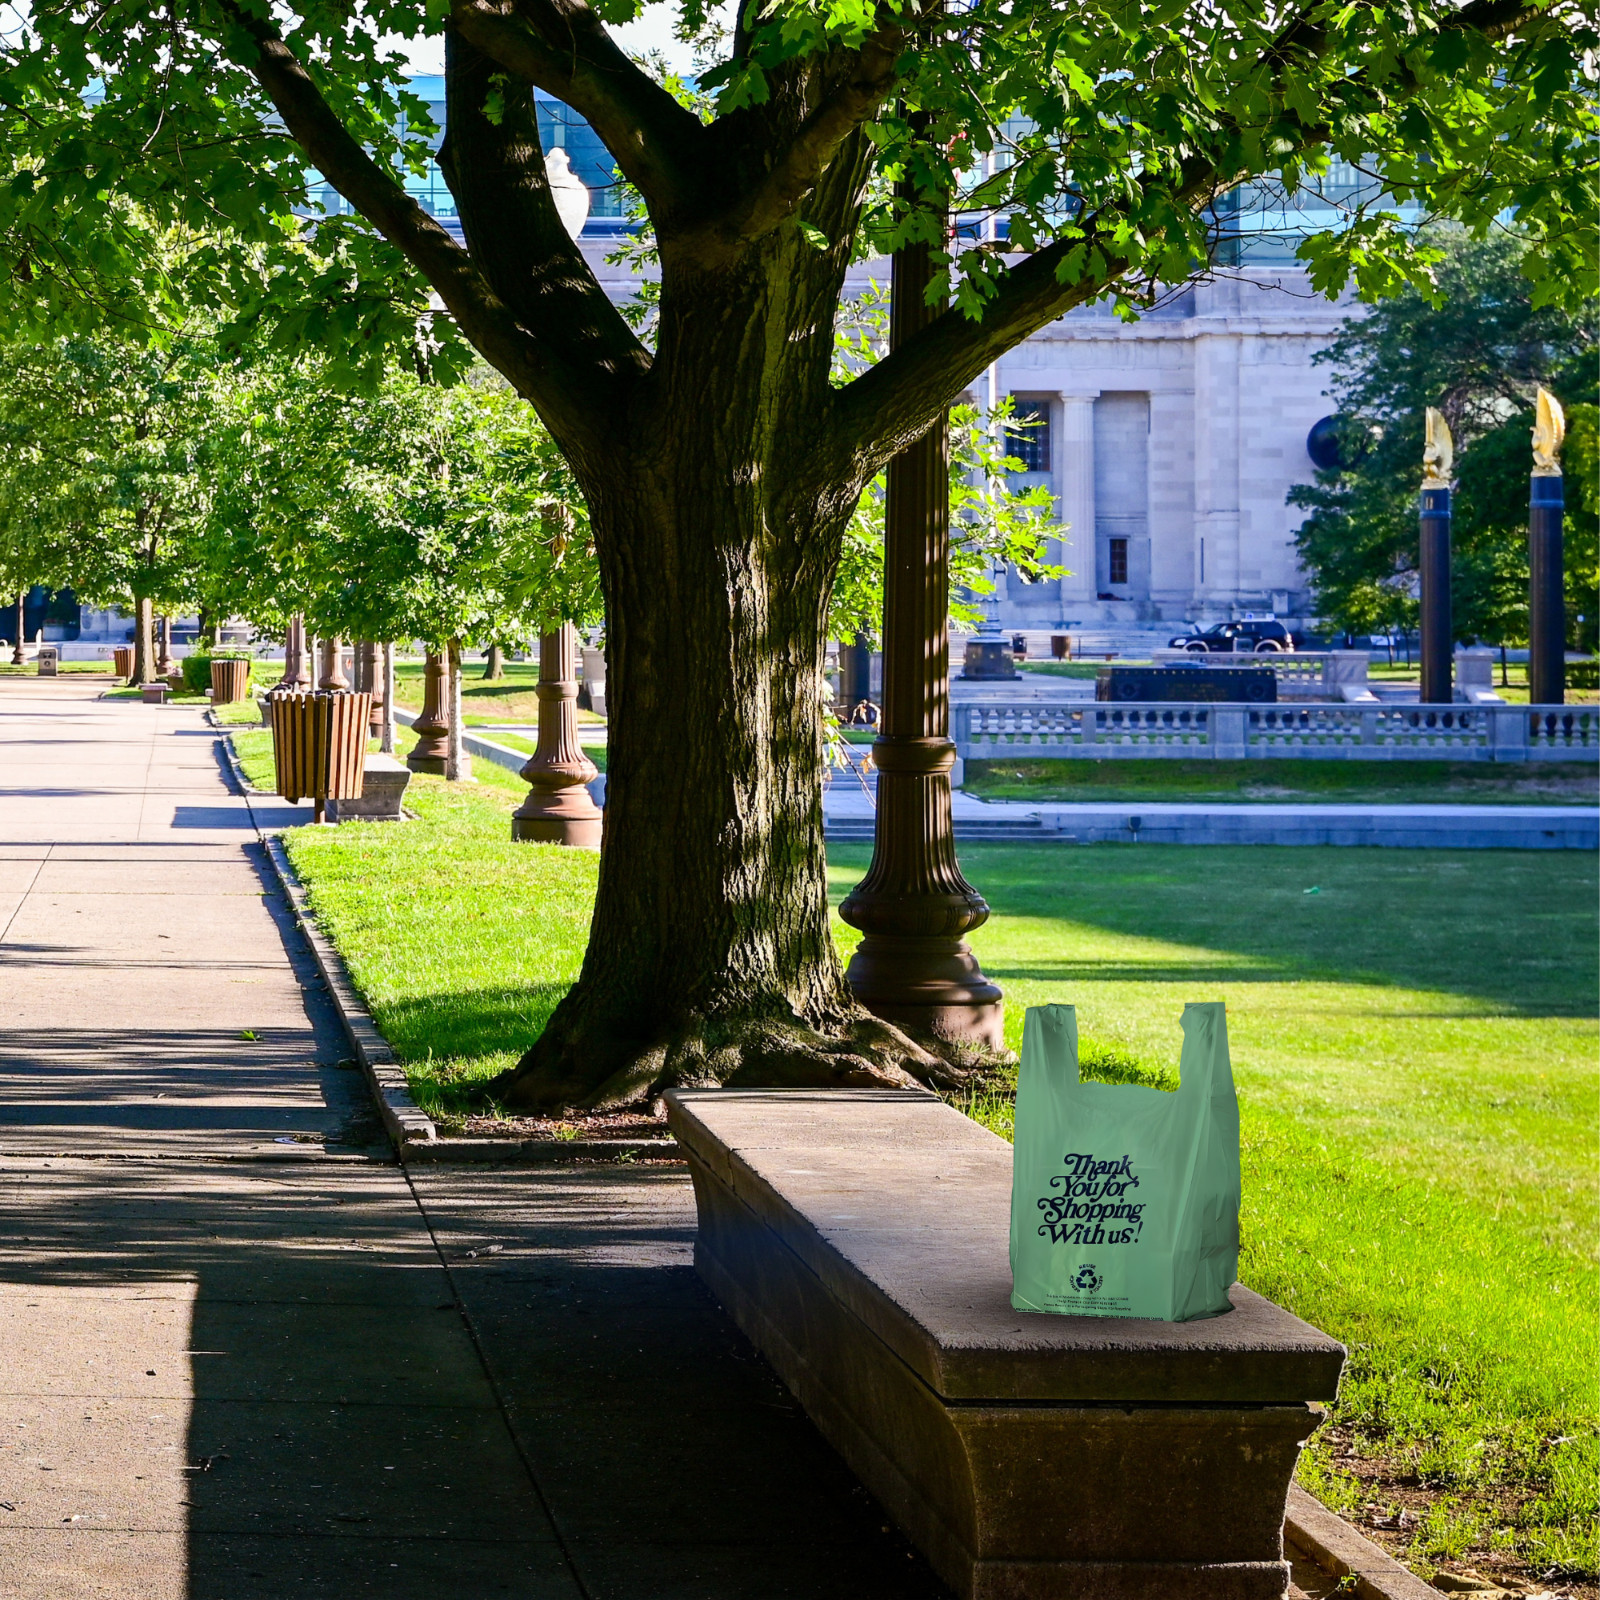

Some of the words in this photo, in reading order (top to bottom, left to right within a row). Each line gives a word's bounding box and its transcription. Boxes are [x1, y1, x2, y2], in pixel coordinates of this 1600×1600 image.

[1064, 1153, 1138, 1181] Thank
[1050, 1175, 1100, 1197] You
[1089, 1174, 1139, 1203] for
[1037, 1196, 1146, 1224] Shopping
[1038, 1223, 1105, 1245] With
[1108, 1221, 1143, 1244] us!
